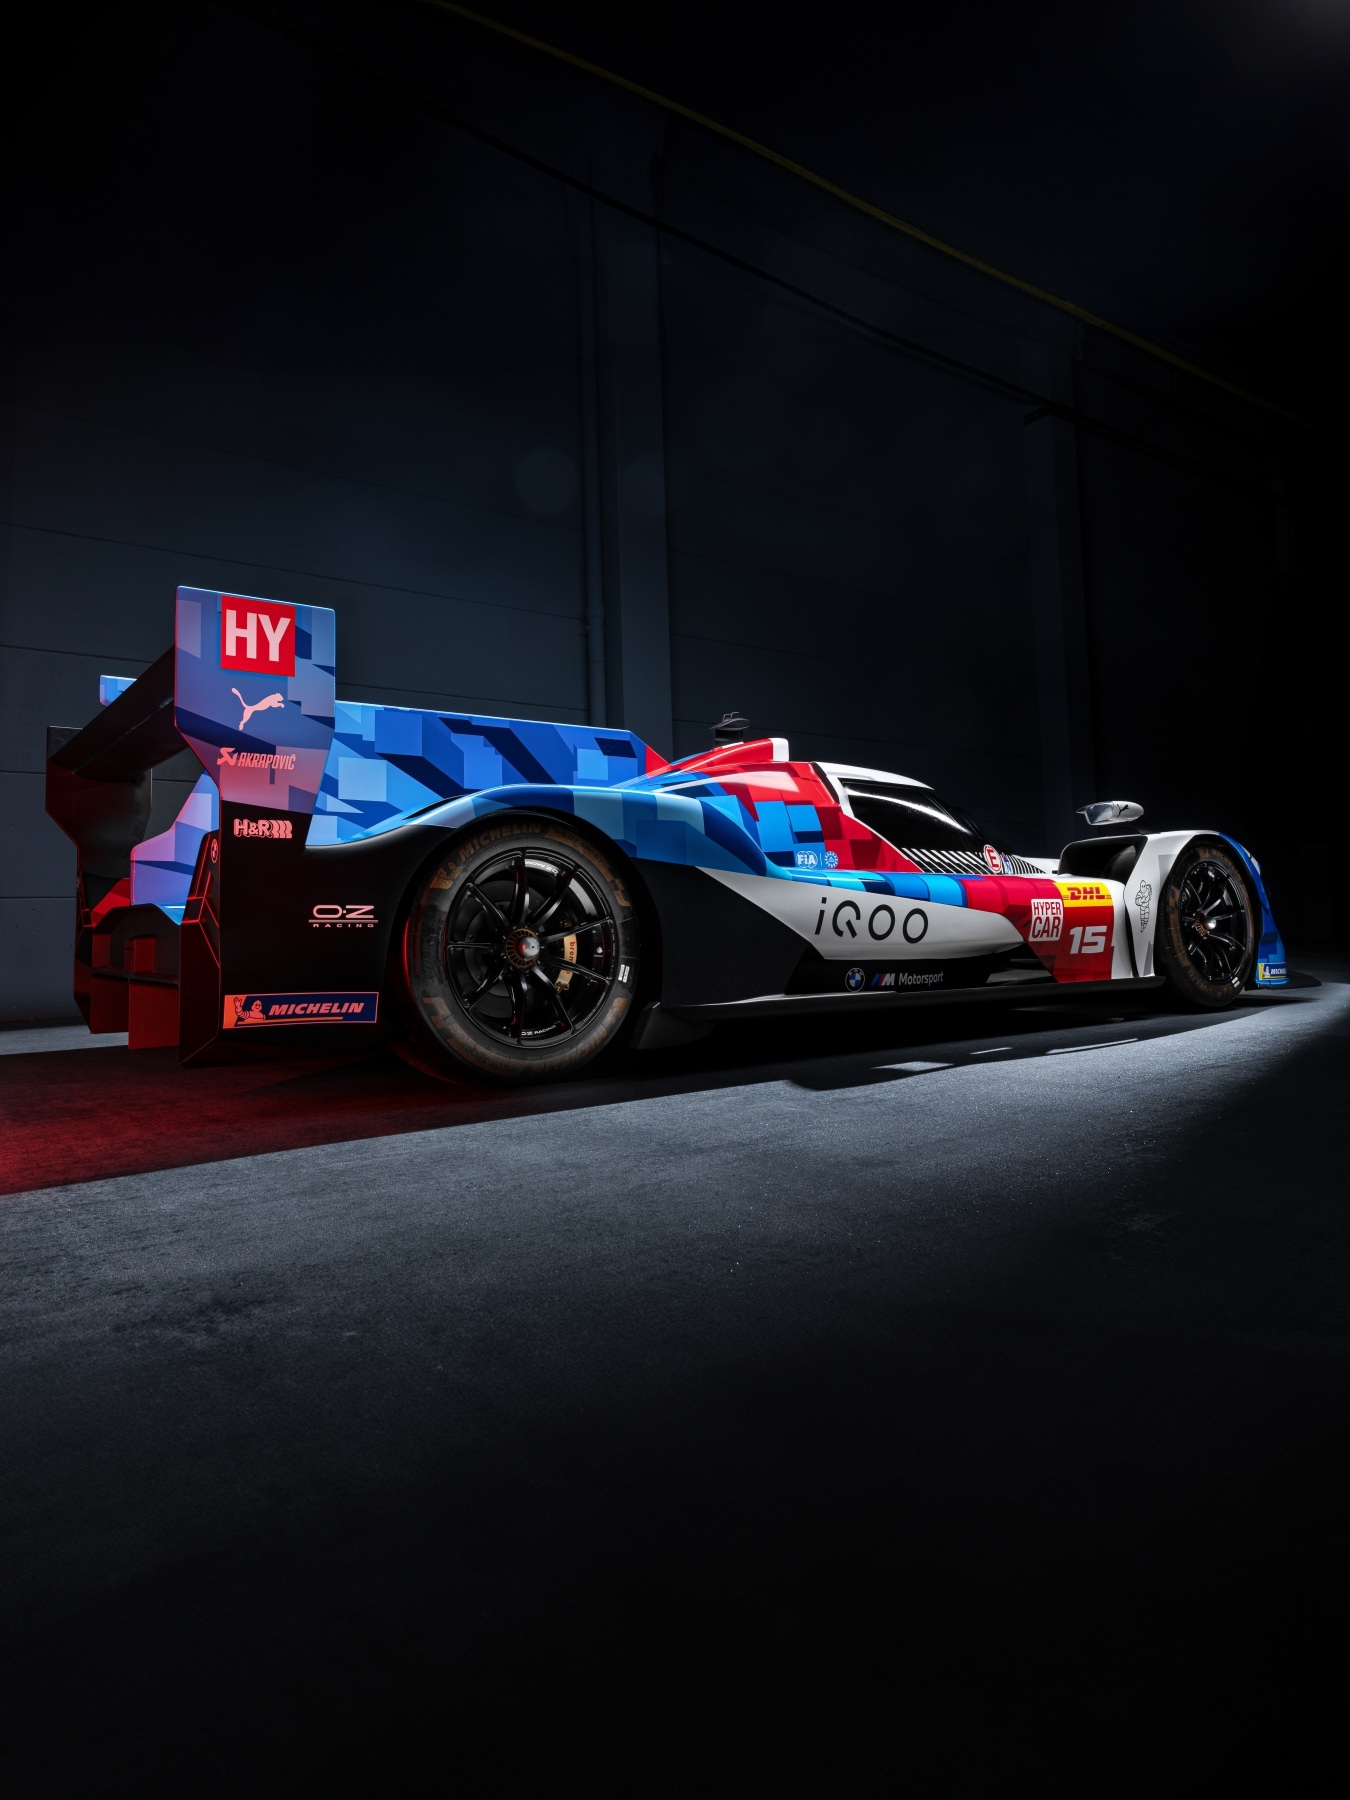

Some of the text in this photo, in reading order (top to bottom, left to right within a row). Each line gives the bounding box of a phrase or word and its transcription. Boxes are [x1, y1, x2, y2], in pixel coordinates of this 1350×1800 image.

[226, 609, 291, 662] HY
[237, 752, 296, 770] AKRAPOVIČ
[233, 818, 273, 838] H&R
[458, 822, 542, 862] MICHELIN
[987, 849, 999, 868] E
[1067, 887, 1105, 900] DHL
[1033, 902, 1061, 915] HYPER
[814, 896, 929, 944] iQOO
[1032, 916, 1061, 938] CAR
[1069, 925, 1108, 955] 15
[898, 970, 944, 986] Motorsport
[268, 1002, 365, 1016] MICHELIN
